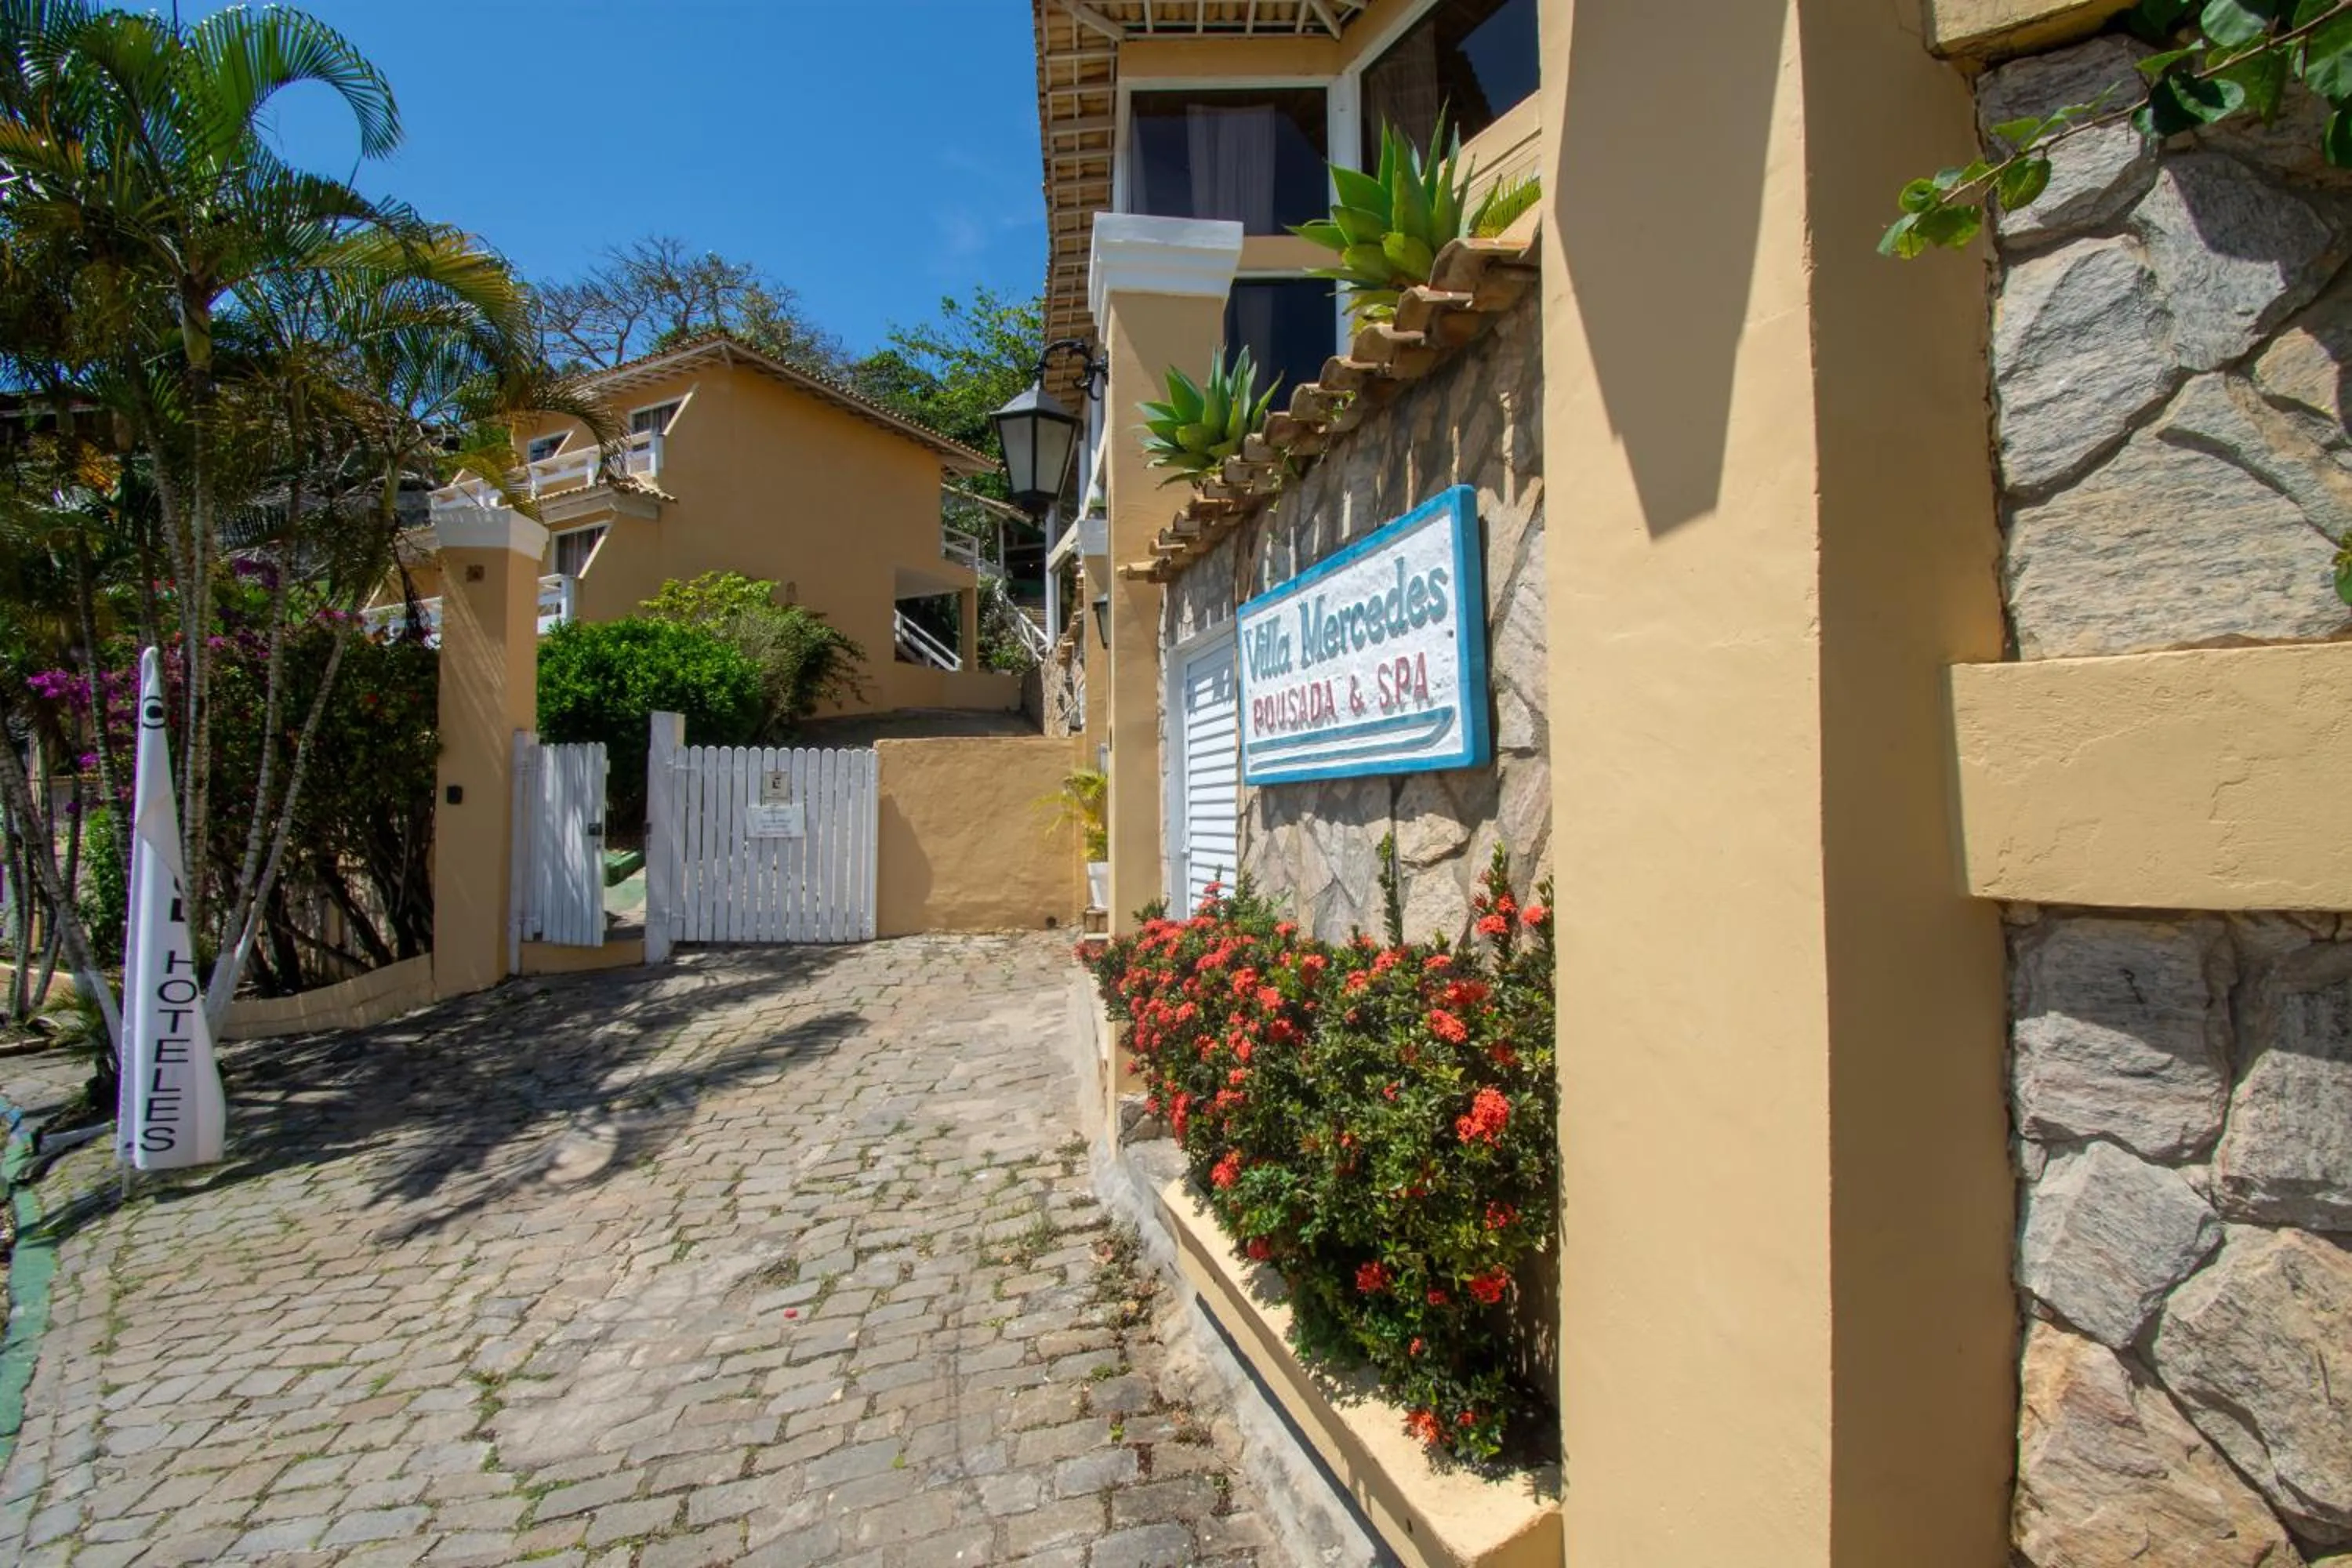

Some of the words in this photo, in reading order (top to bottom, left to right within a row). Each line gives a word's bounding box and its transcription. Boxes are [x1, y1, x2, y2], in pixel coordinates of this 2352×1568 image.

[1242, 615, 1293, 682] Villa
[1298, 557, 1450, 670] Mercedes
[1254, 680, 1337, 735] POUSADA
[1349, 674, 1367, 717] &
[1377, 652, 1430, 712] SPA
